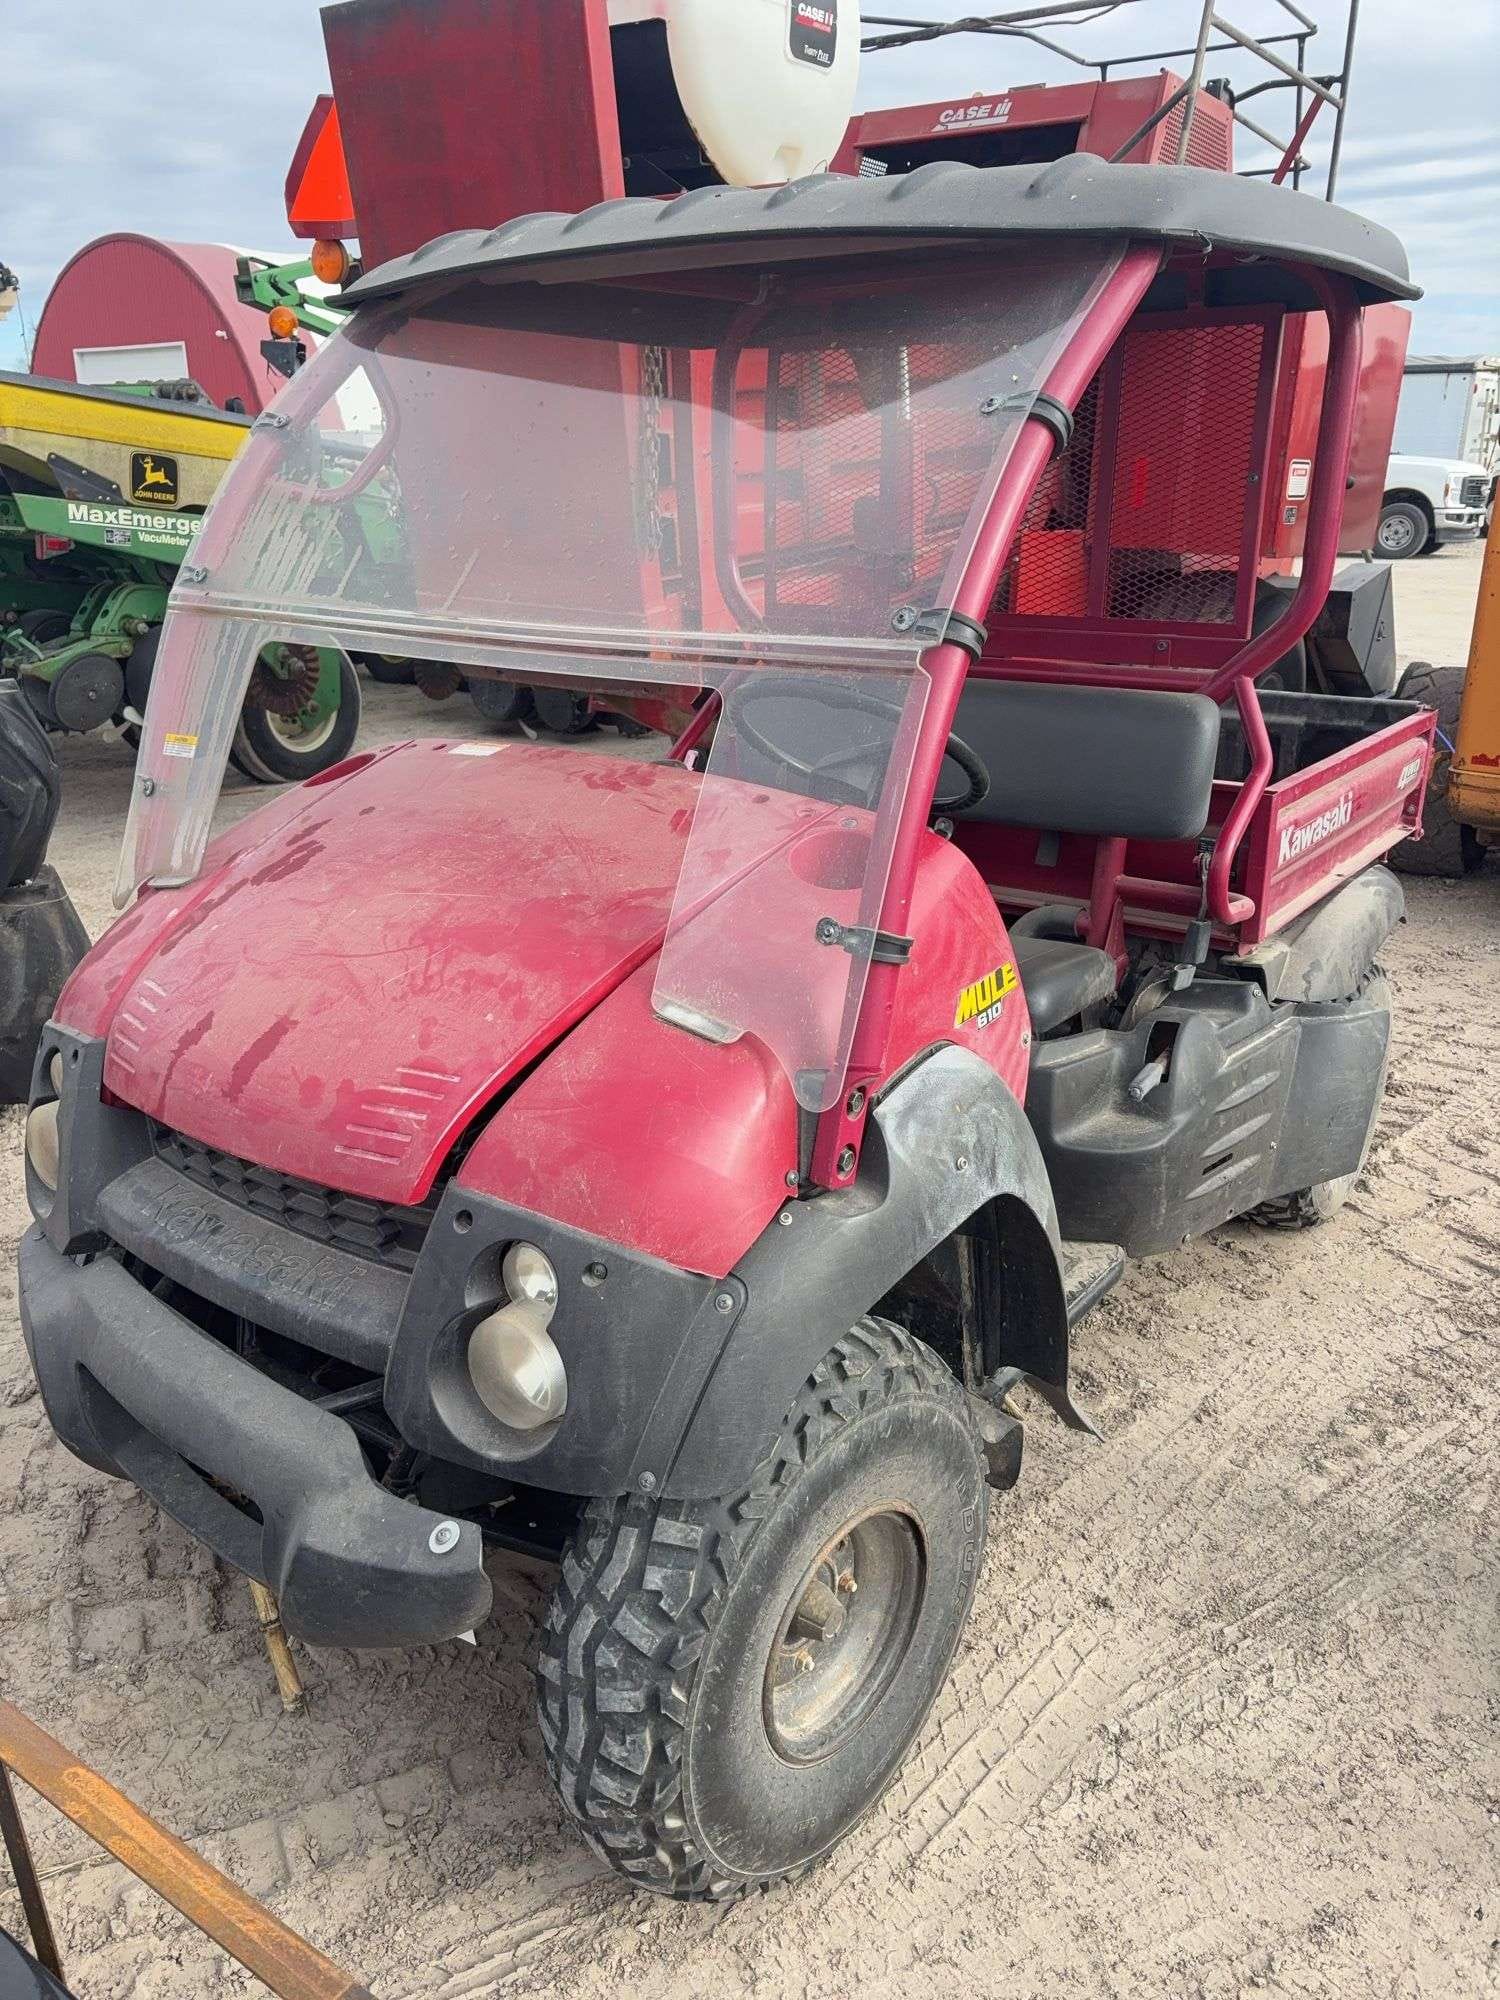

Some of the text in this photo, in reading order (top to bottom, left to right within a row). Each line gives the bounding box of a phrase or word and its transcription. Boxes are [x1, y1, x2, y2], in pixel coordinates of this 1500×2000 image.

[797, 2, 825, 23] CASE
[939, 104, 992, 123] CASE
[134, 489, 176, 502] JOHN DEERE
[67, 502, 202, 535] MaxEmerge
[137, 531, 190, 546] VacuMeter
[1279, 791, 1354, 866] Kawasaki
[955, 960, 1020, 1026] MULE
[977, 1000, 1002, 1029] 610
[152, 1183, 368, 1310] Kawasaki
